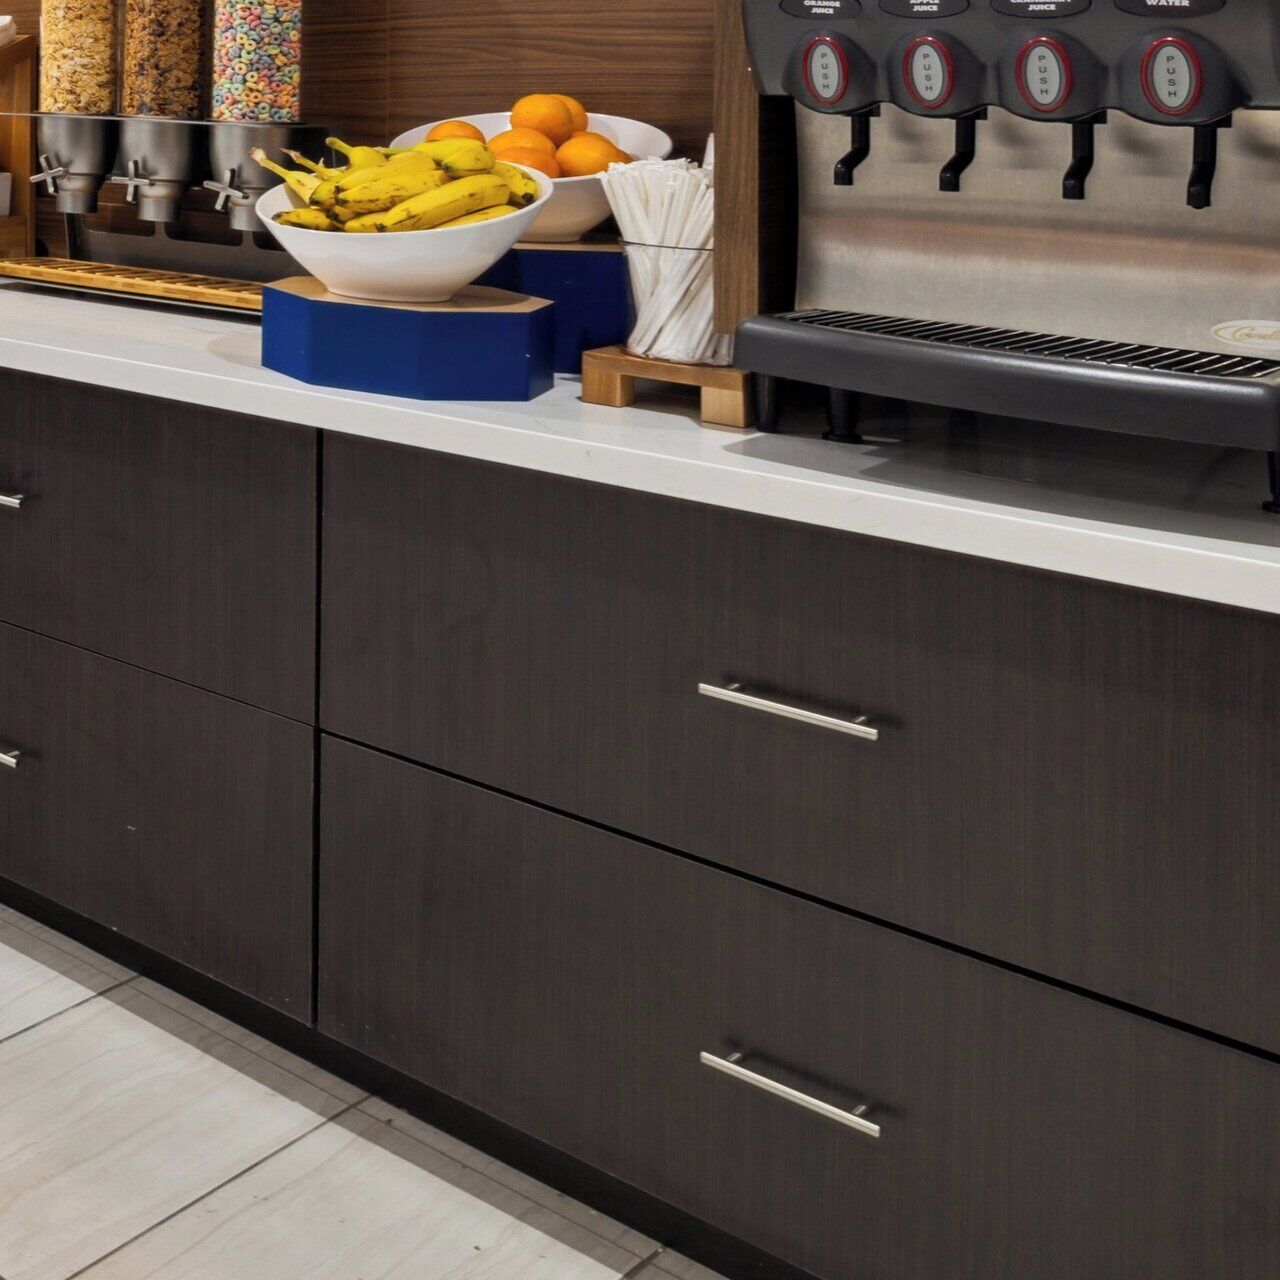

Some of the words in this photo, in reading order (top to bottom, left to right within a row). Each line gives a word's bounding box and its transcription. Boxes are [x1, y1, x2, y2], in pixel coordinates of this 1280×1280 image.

[803, 0, 841, 8] ORANGE
[811, 7, 834, 15] JUICE
[1027, 3, 1056, 12] JUICE
[820, 52, 830, 90] PUSH
[922, 53, 933, 93] PUSH
[1037, 54, 1049, 96] PUSH
[1165, 55, 1177, 98] PUSH
